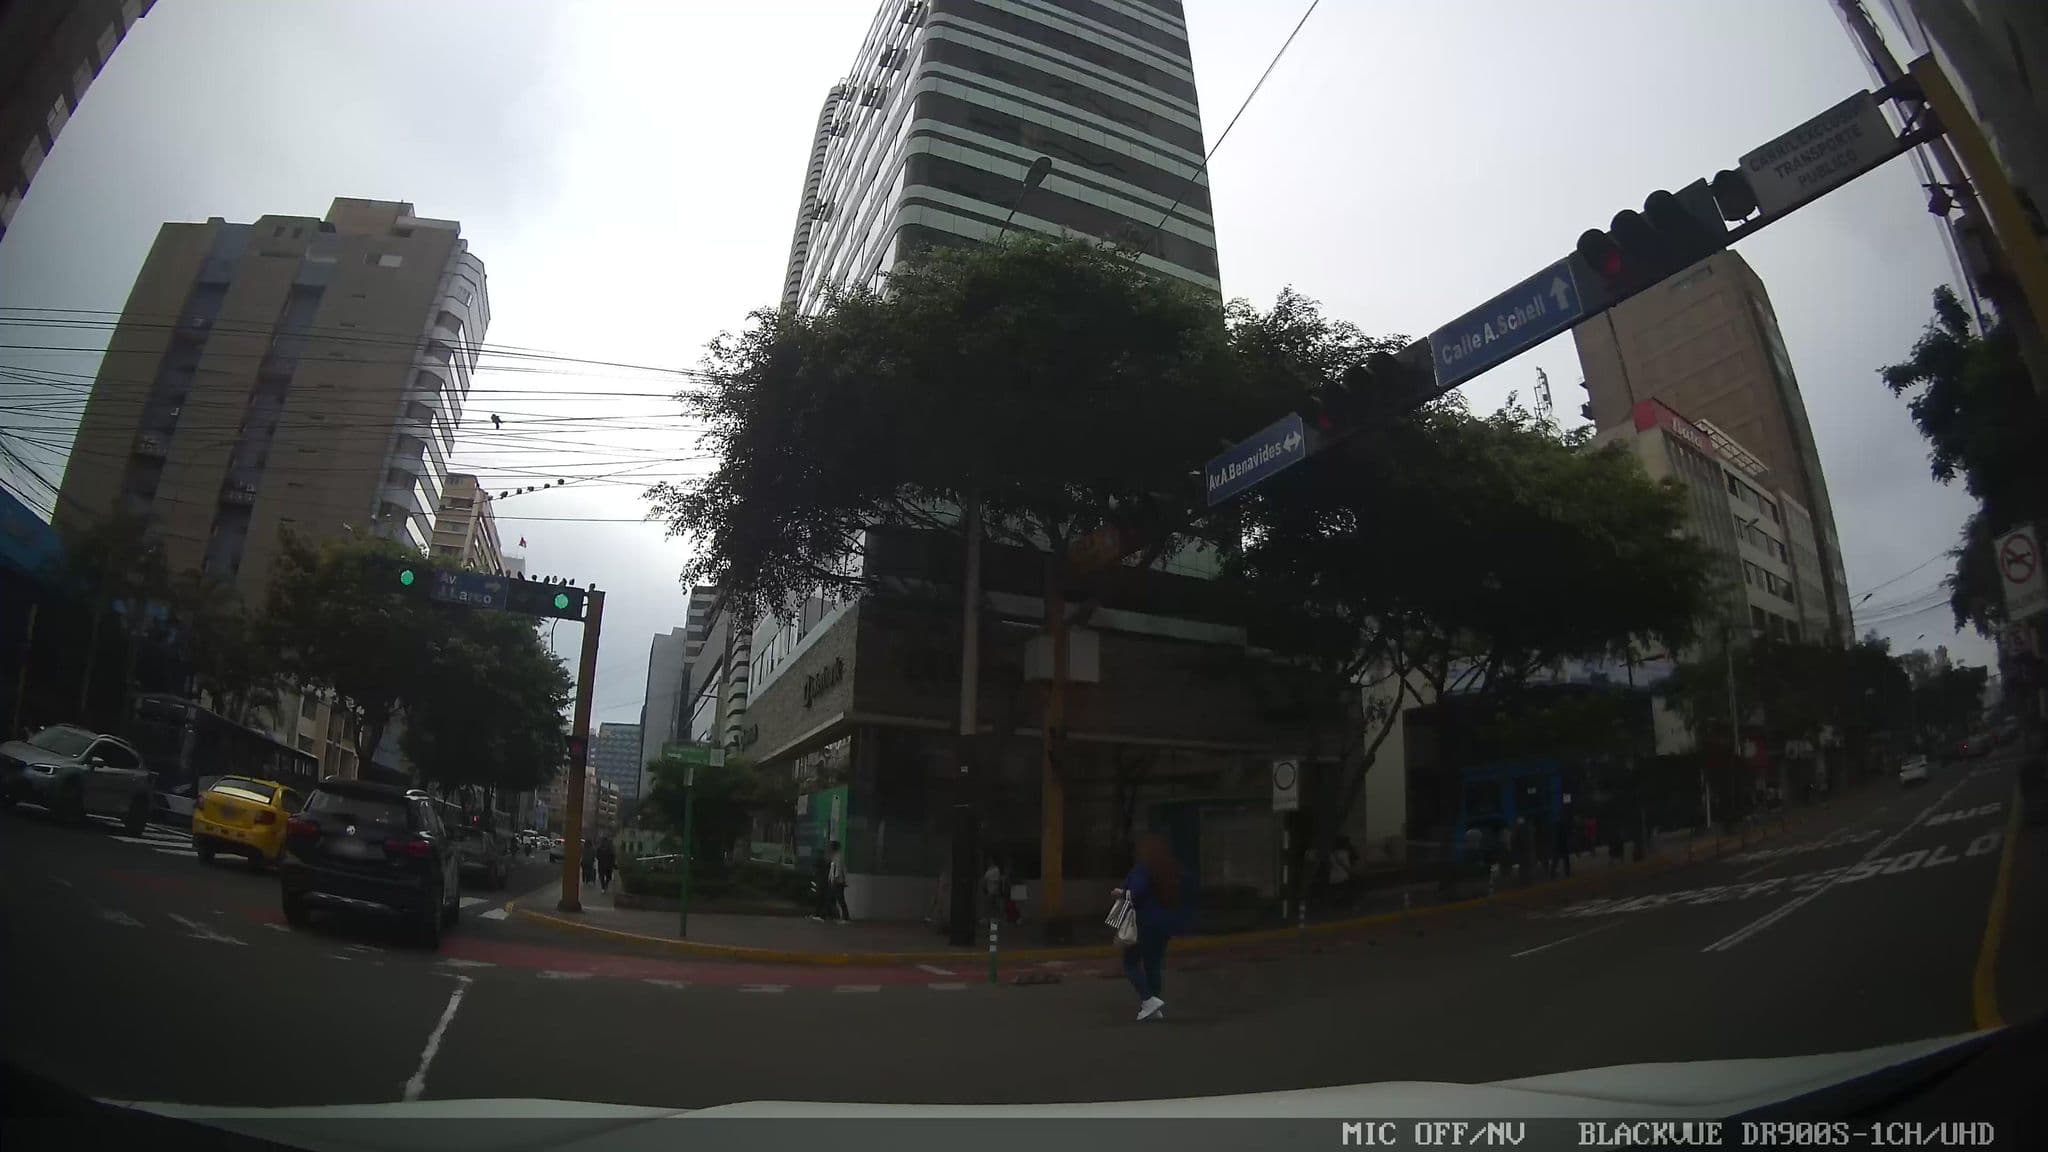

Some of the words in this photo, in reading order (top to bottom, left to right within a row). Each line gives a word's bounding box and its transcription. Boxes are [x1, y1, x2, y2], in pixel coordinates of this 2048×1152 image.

[1773, 123, 1864, 179] TRANSPORTE
[1442, 331, 1481, 365] Calle
[1837, 833, 2000, 884] SOLO
